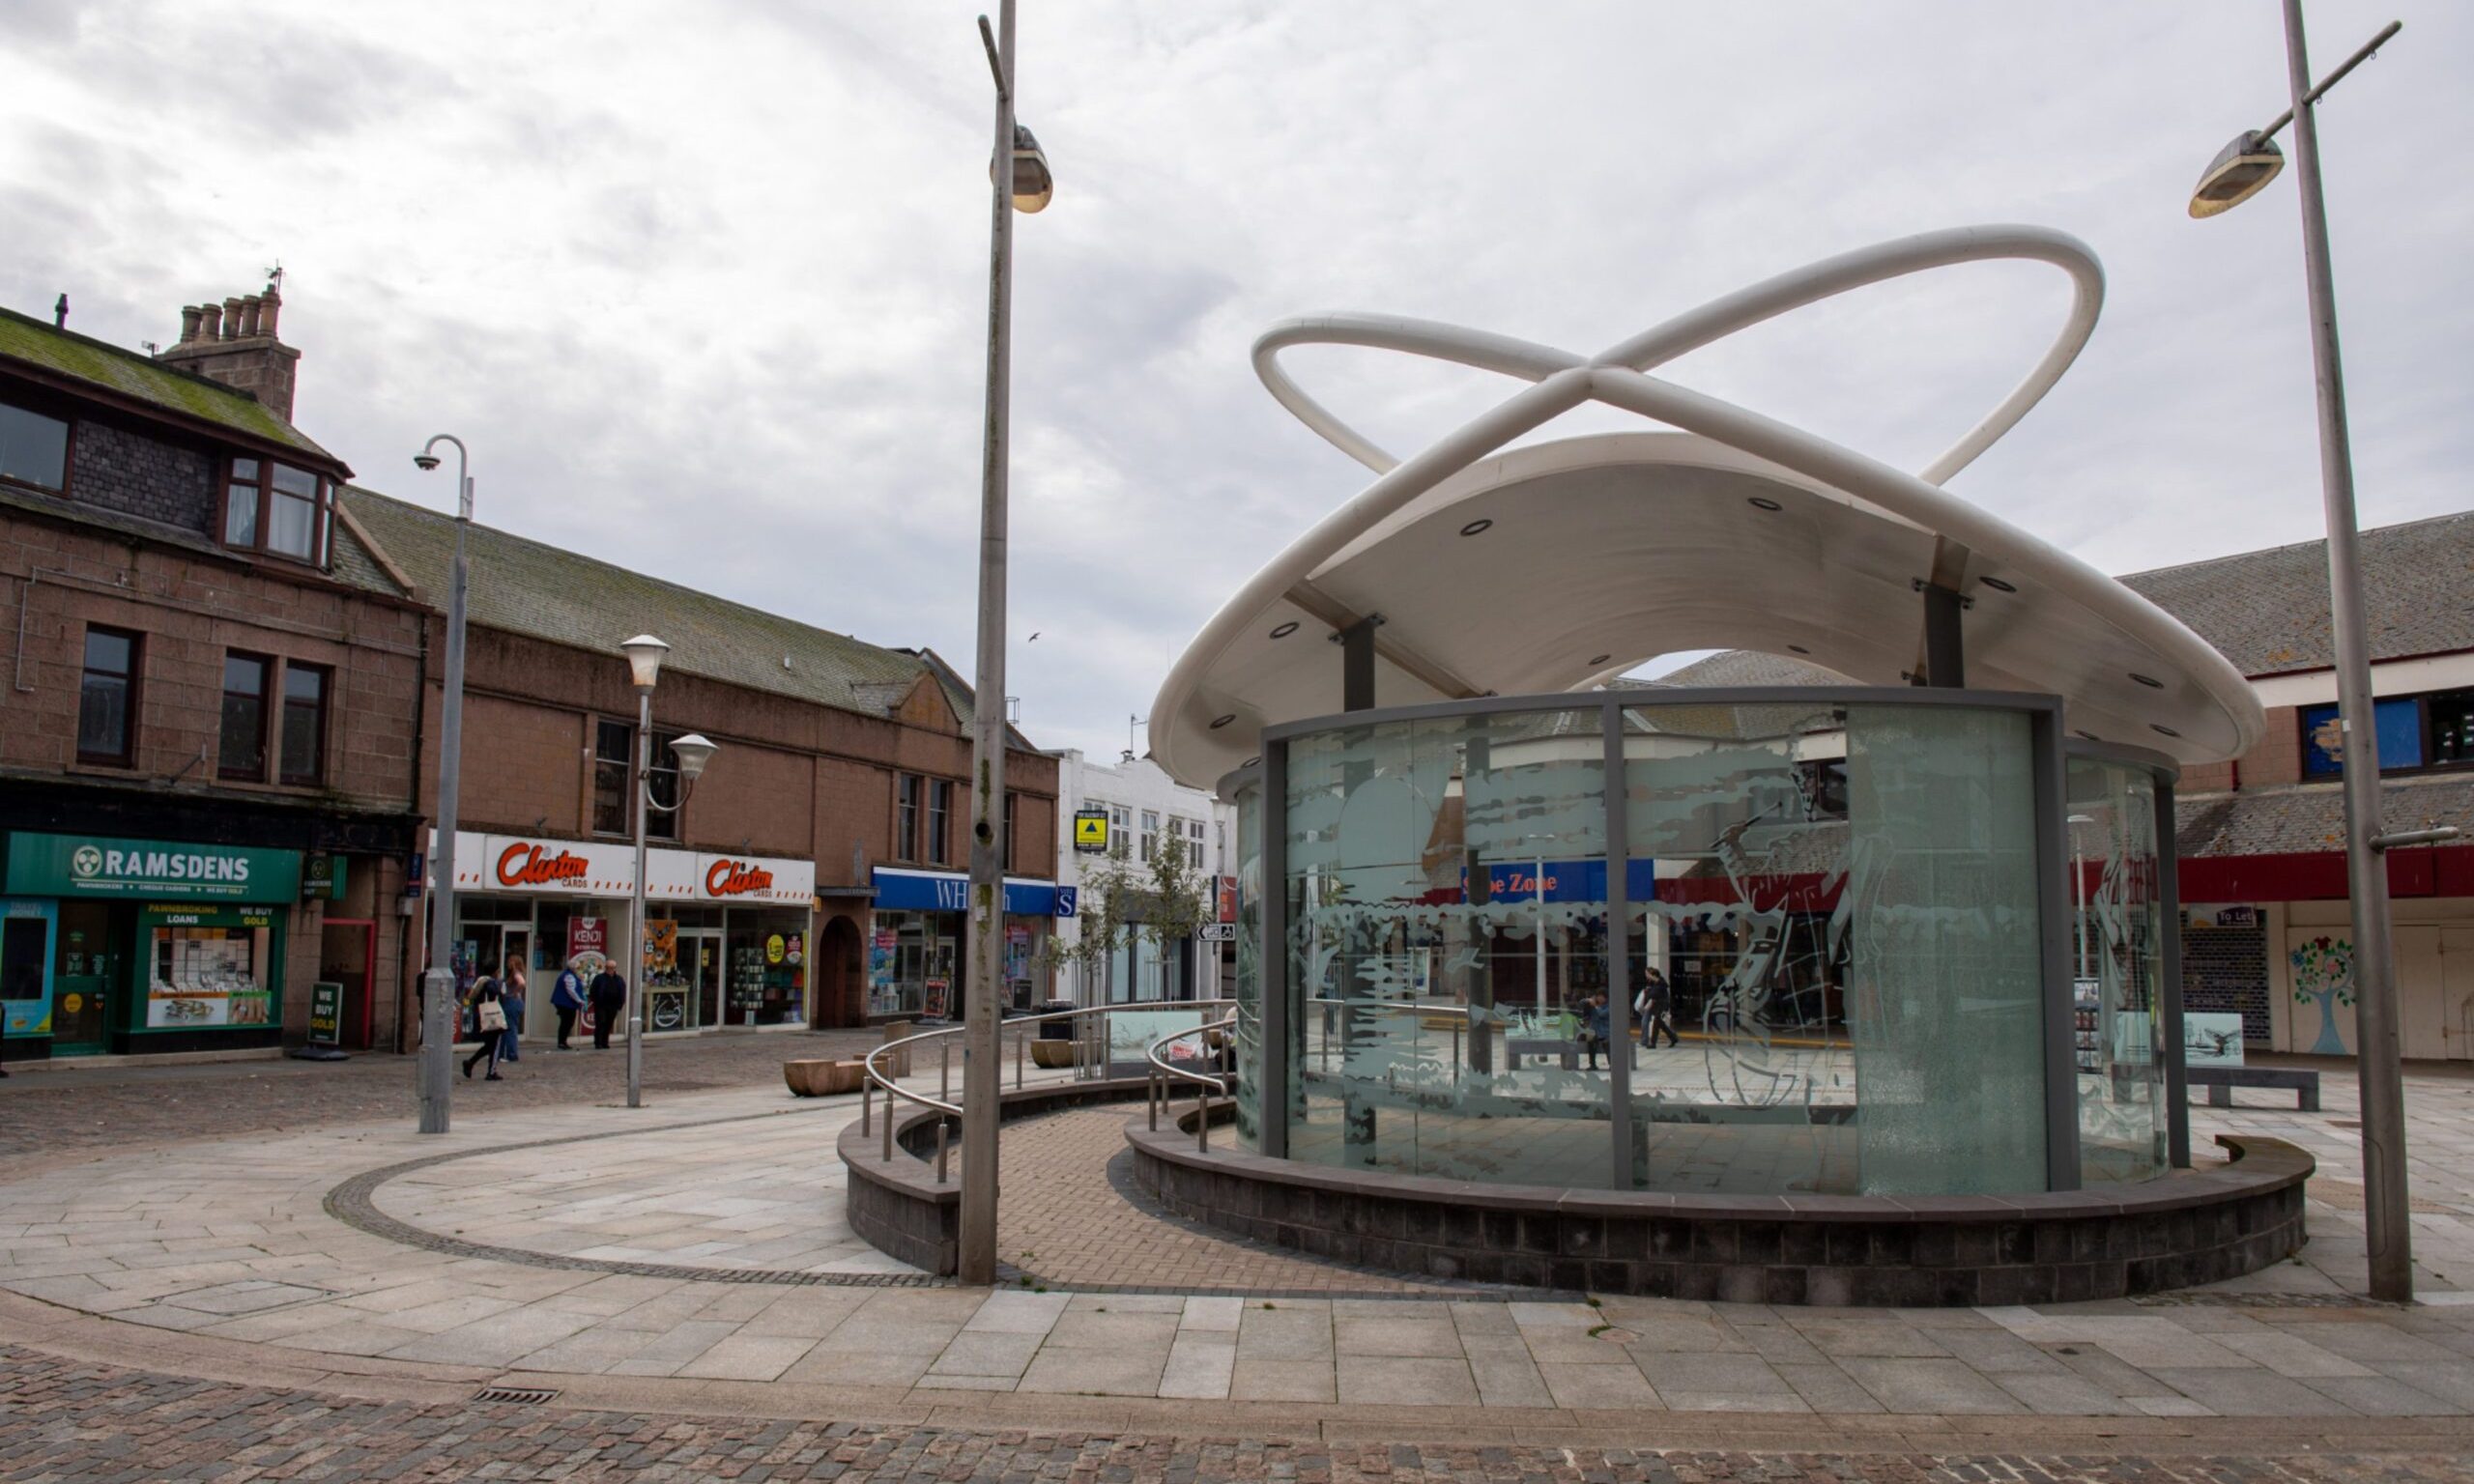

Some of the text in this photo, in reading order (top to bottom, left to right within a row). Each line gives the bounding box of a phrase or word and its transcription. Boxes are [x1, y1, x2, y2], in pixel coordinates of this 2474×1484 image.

[105, 850, 248, 881] RAMSDENS
[497, 842, 589, 886] Clinton
[561, 878, 588, 888] CARDS
[705, 859, 773, 897] Clinton
[754, 889, 772, 899] CARDS
[148, 904, 217, 914] PAWNBROKING
[254, 907, 273, 916] BUY
[166, 915, 199, 924] LOANS
[2220, 911, 2252, 921] To Let
[574, 929, 602, 943] KENJI
[319, 990, 332, 1001] WE
[315, 1004, 333, 1015] BUY
[310, 1017, 335, 1030] GOLD
